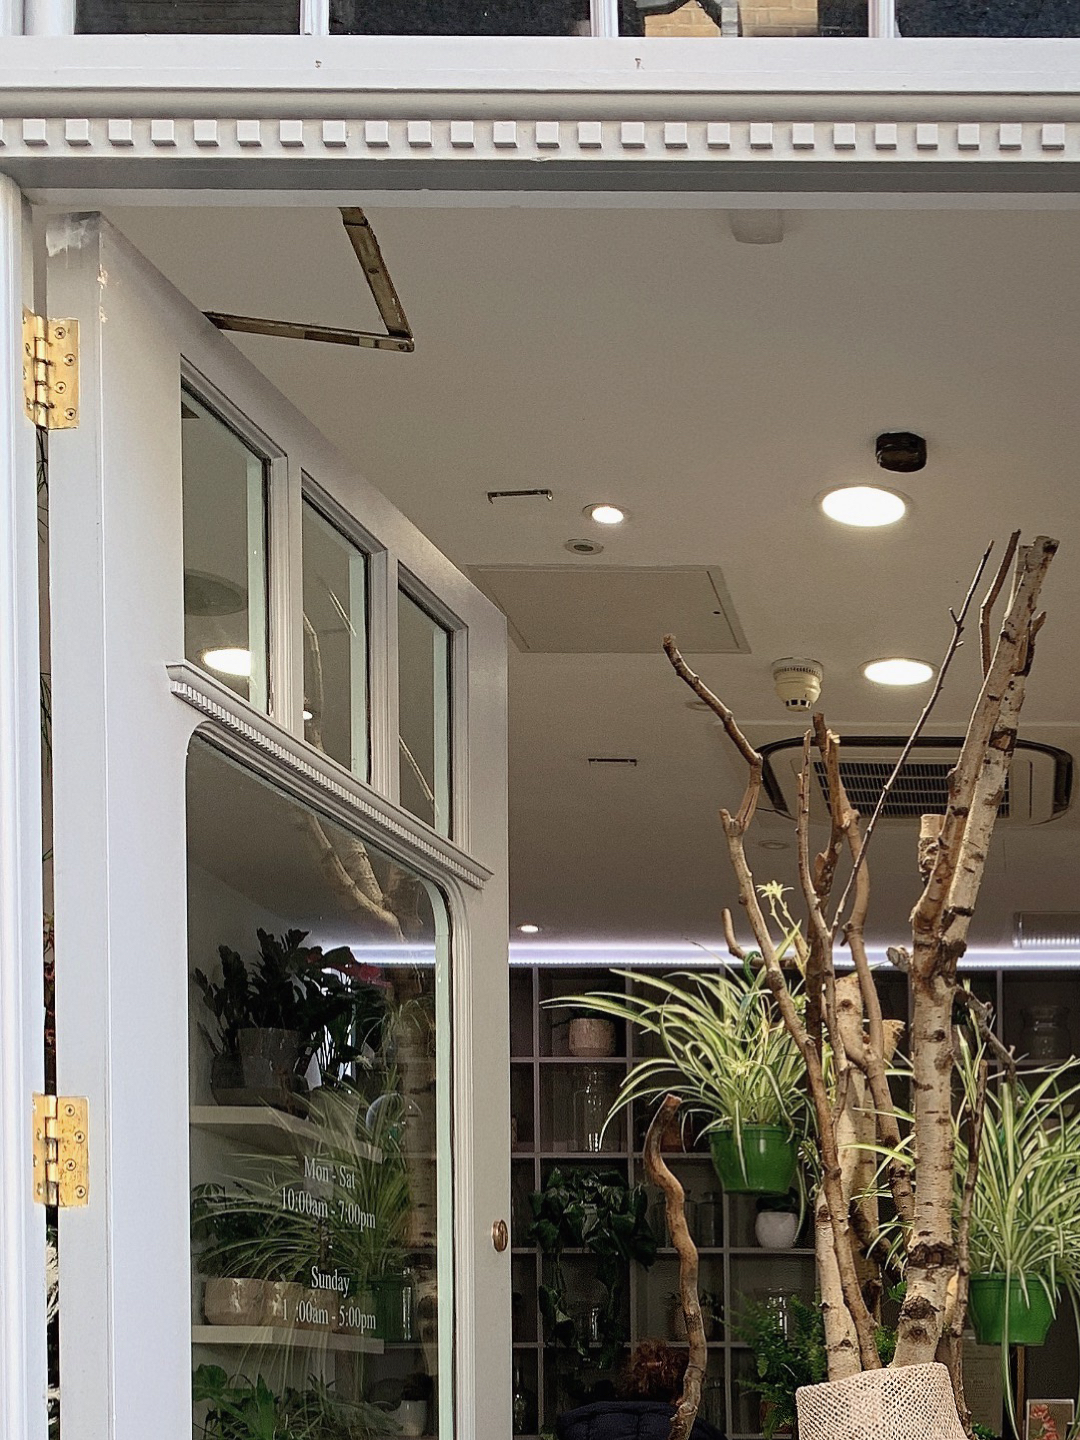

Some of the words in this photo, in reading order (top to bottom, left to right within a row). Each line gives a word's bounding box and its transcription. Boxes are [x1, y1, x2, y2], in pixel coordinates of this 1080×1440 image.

[303, 1156, 329, 1183] Mon
[339, 1165, 356, 1190] Sat
[282, 1187, 328, 1218] 10:00am
[338, 1200, 376, 1232] 7:00pm
[311, 1265, 350, 1299] Sunday
[339, 1305, 376, 1334] 5:00pm
